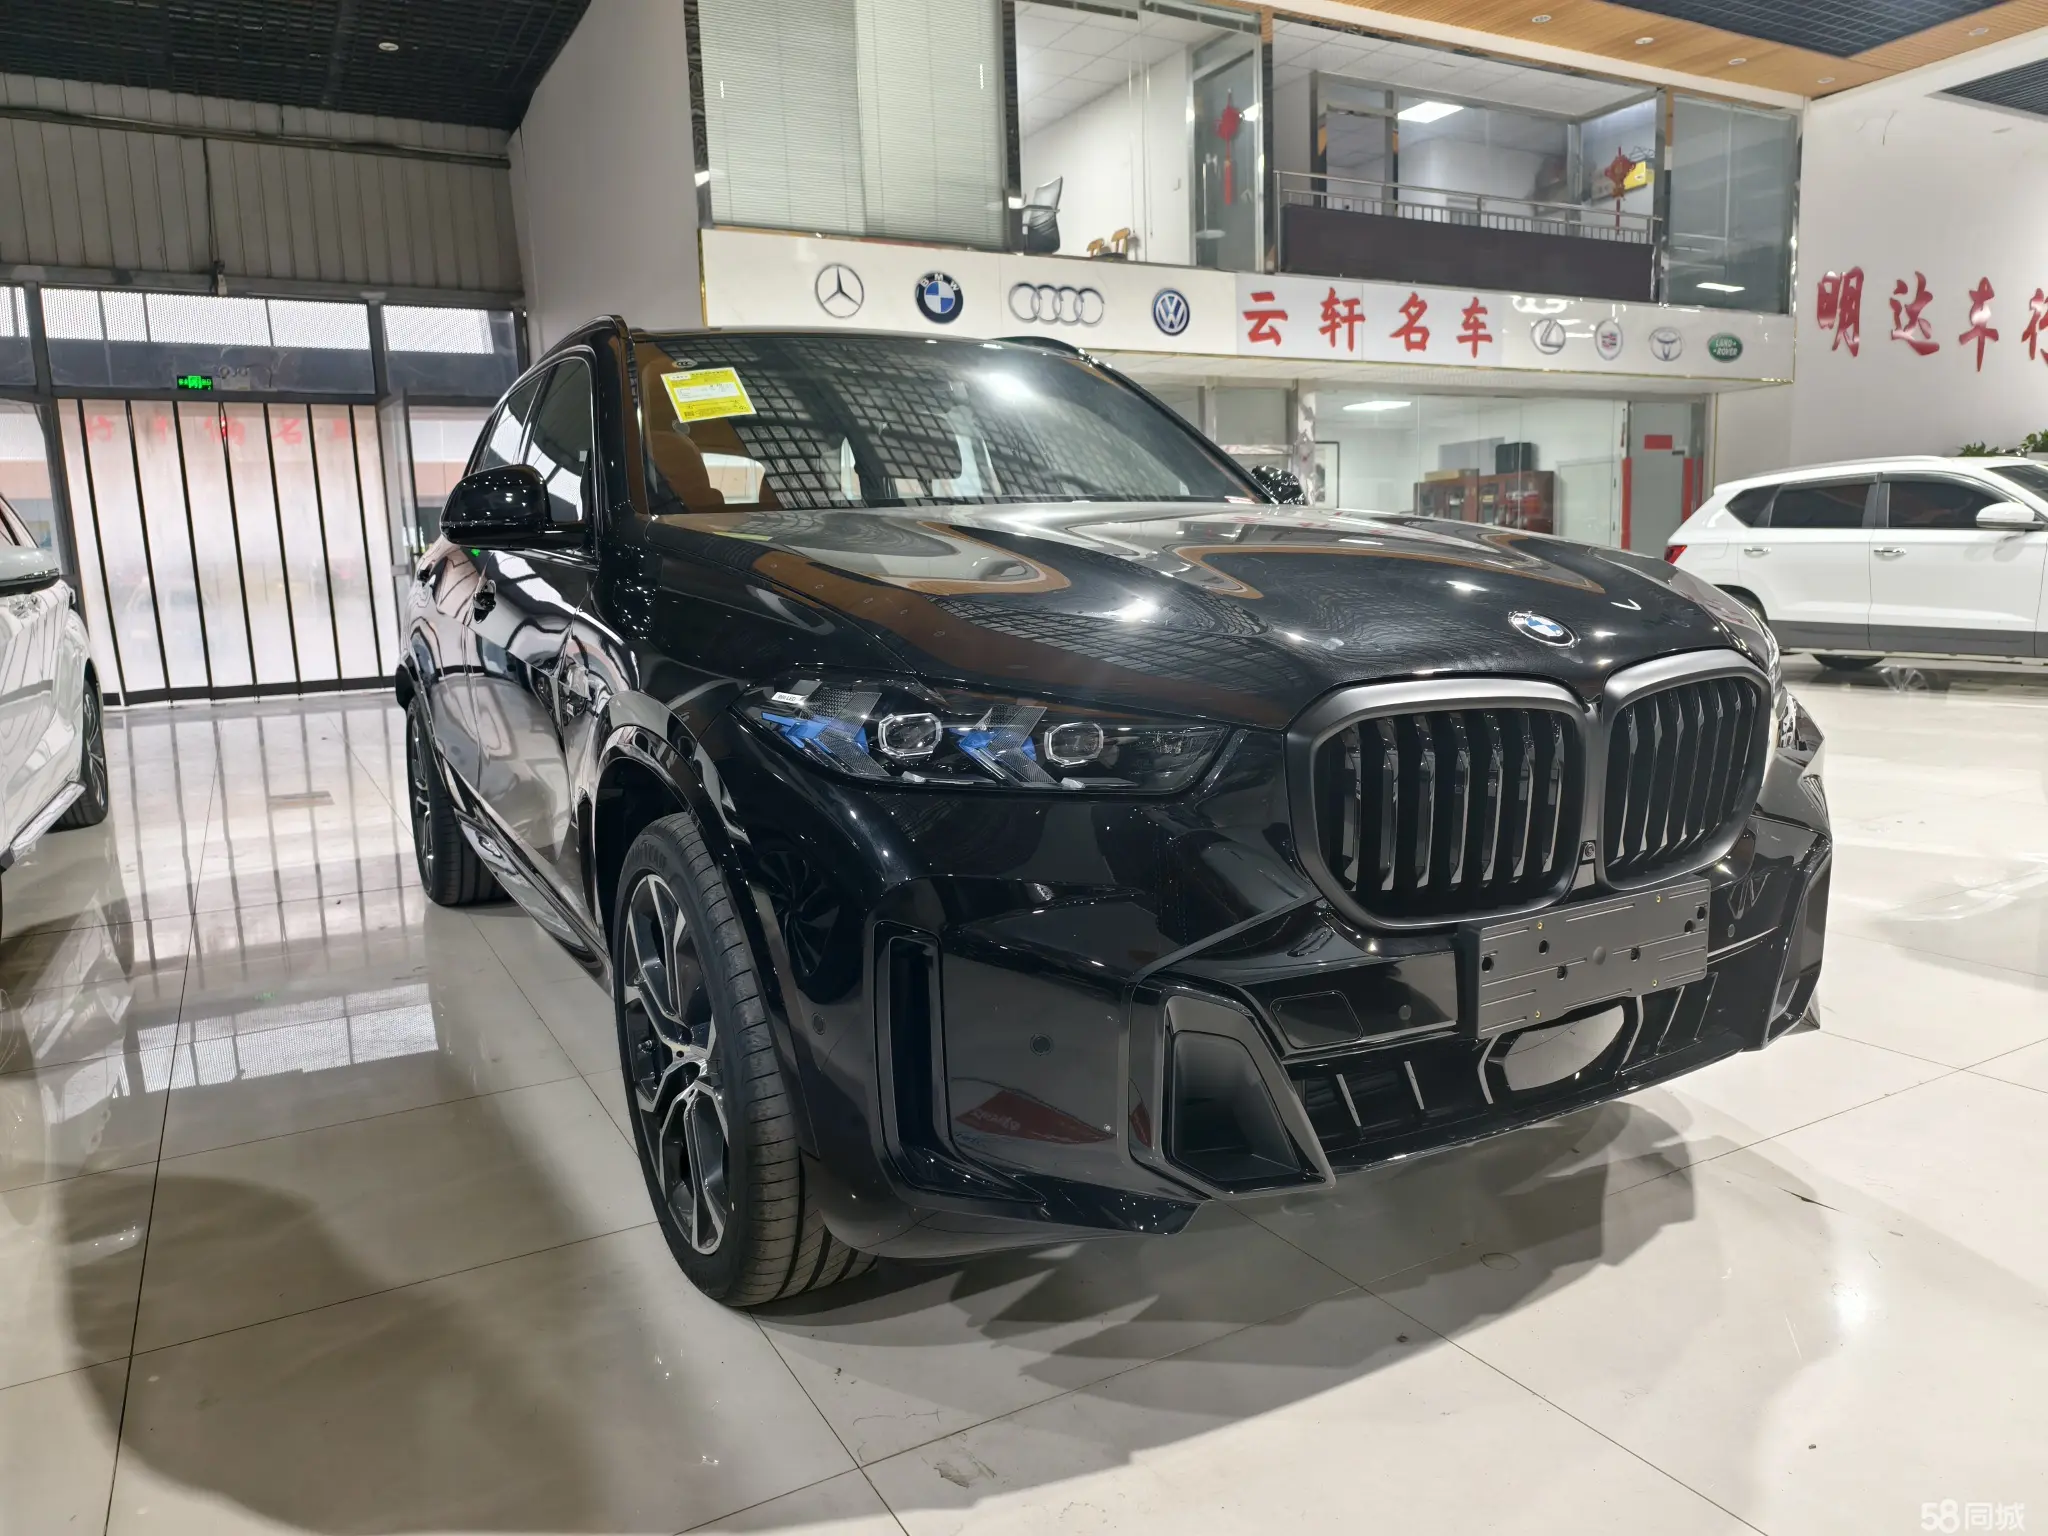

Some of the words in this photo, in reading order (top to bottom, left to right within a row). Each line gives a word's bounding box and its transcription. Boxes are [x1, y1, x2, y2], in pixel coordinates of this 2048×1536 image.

[920, 273, 960, 291] BMW
[1242, 287, 1494, 359] 云轩名车
[1715, 339, 1733, 348] LAND
[1716, 347, 1738, 356] ROVER
